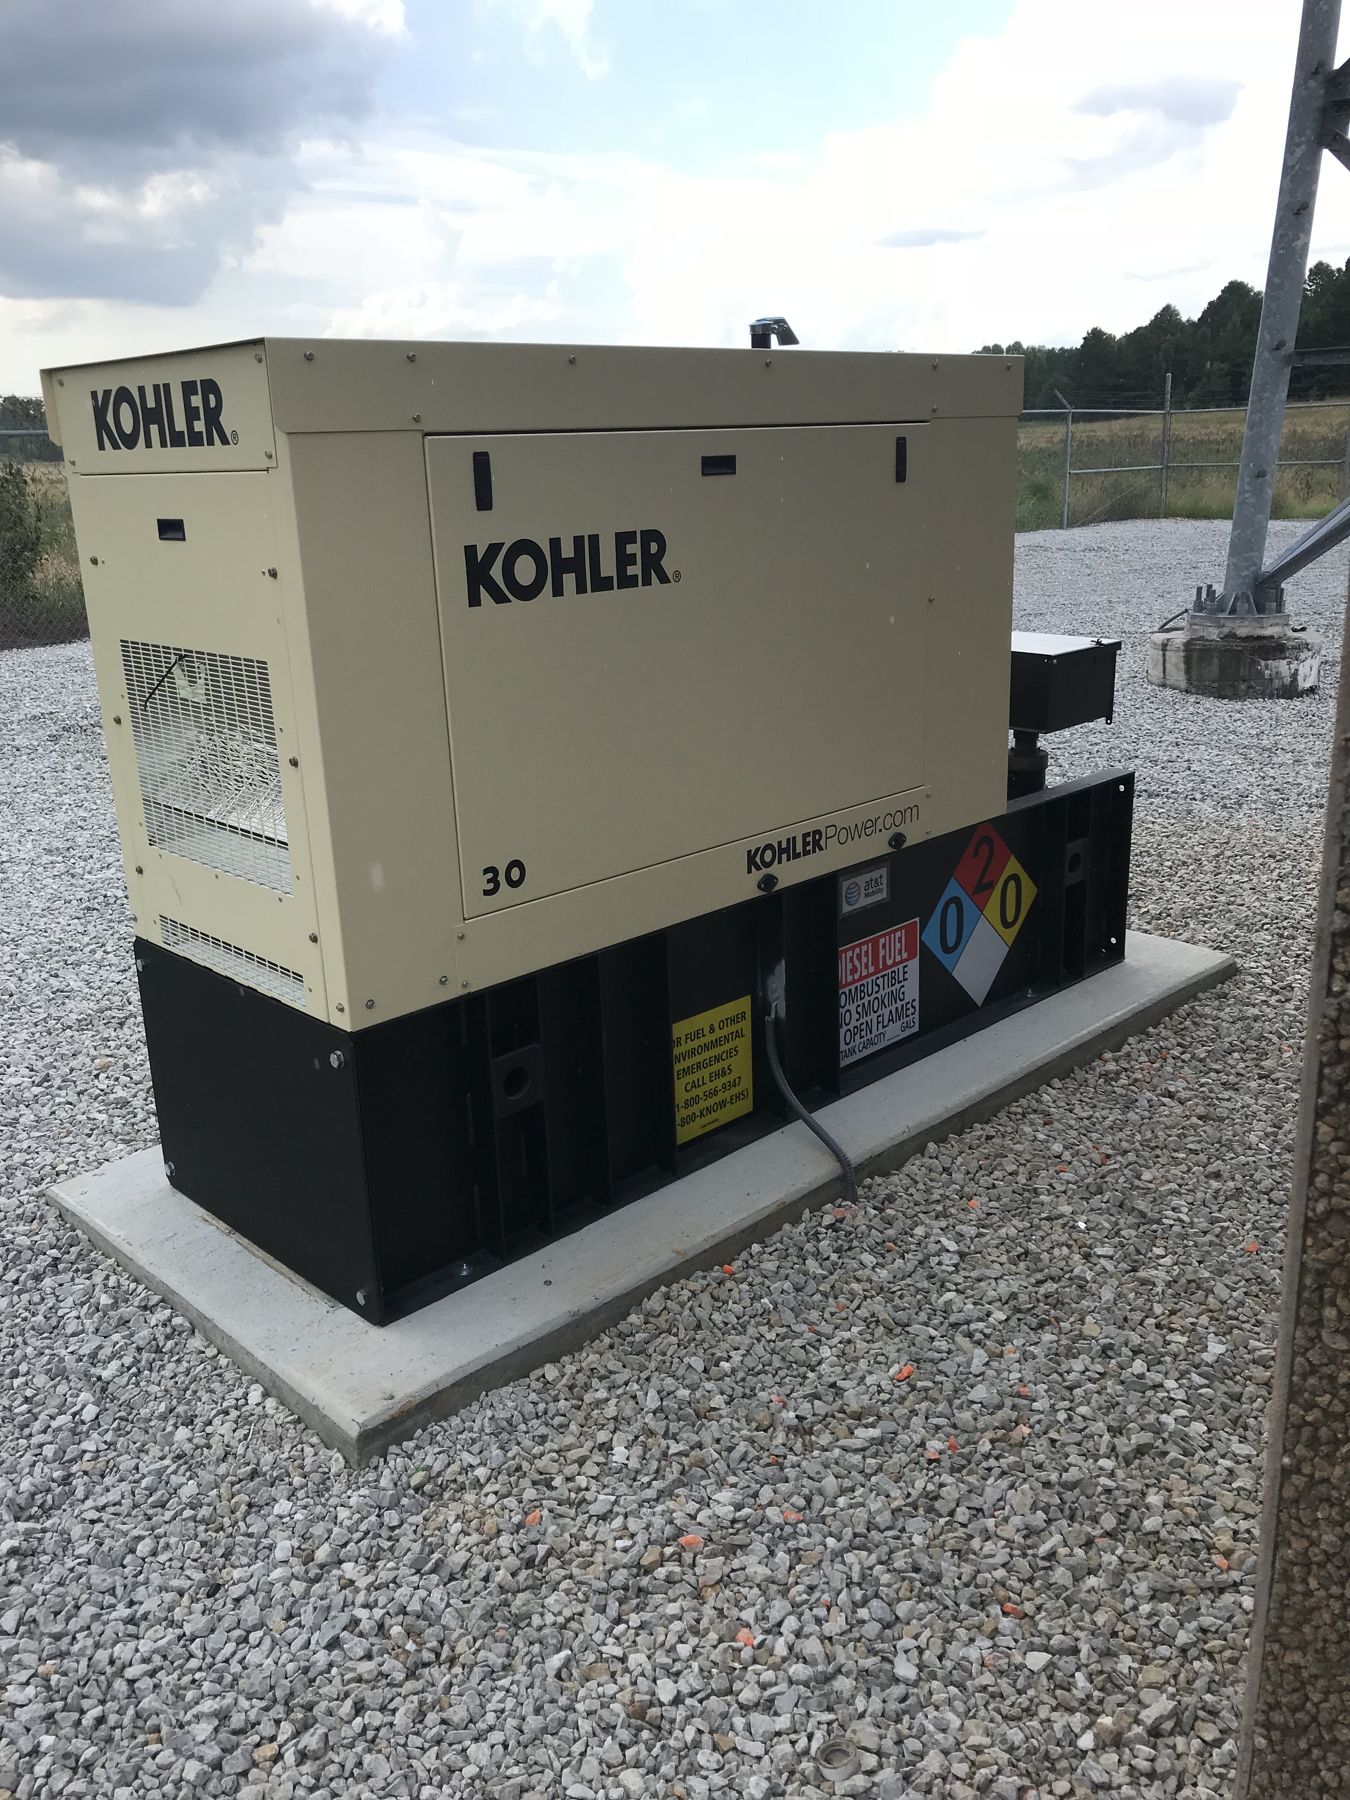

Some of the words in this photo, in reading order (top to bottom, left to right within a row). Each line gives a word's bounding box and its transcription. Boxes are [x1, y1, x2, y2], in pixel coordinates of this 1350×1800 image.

[747, 804, 919, 875] KOHLERPower.com
[482, 859, 526, 897] 30
[864, 874, 884, 891] at&t
[972, 835, 995, 896] 2
[939, 896, 964, 955] 0
[999, 872, 1023, 930] 0
[838, 942, 875, 985] IESEL
[879, 929, 908, 969] FUEL
[843, 1017, 873, 1046] OPEN
[876, 998, 917, 1033] FLAMES
[855, 984, 906, 1023] SMOKING
[684, 1027, 706, 1044] FUEL
[708, 1023, 716, 1034] &
[718, 1011, 746, 1030] OTHER
[857, 1030, 887, 1053] CAPACITY
[901, 1017, 916, 1032] GALS
[676, 1045, 739, 1080] EMERGENCIES
[684, 1075, 707, 1093] CALL
[709, 1063, 733, 1083] EH&S
